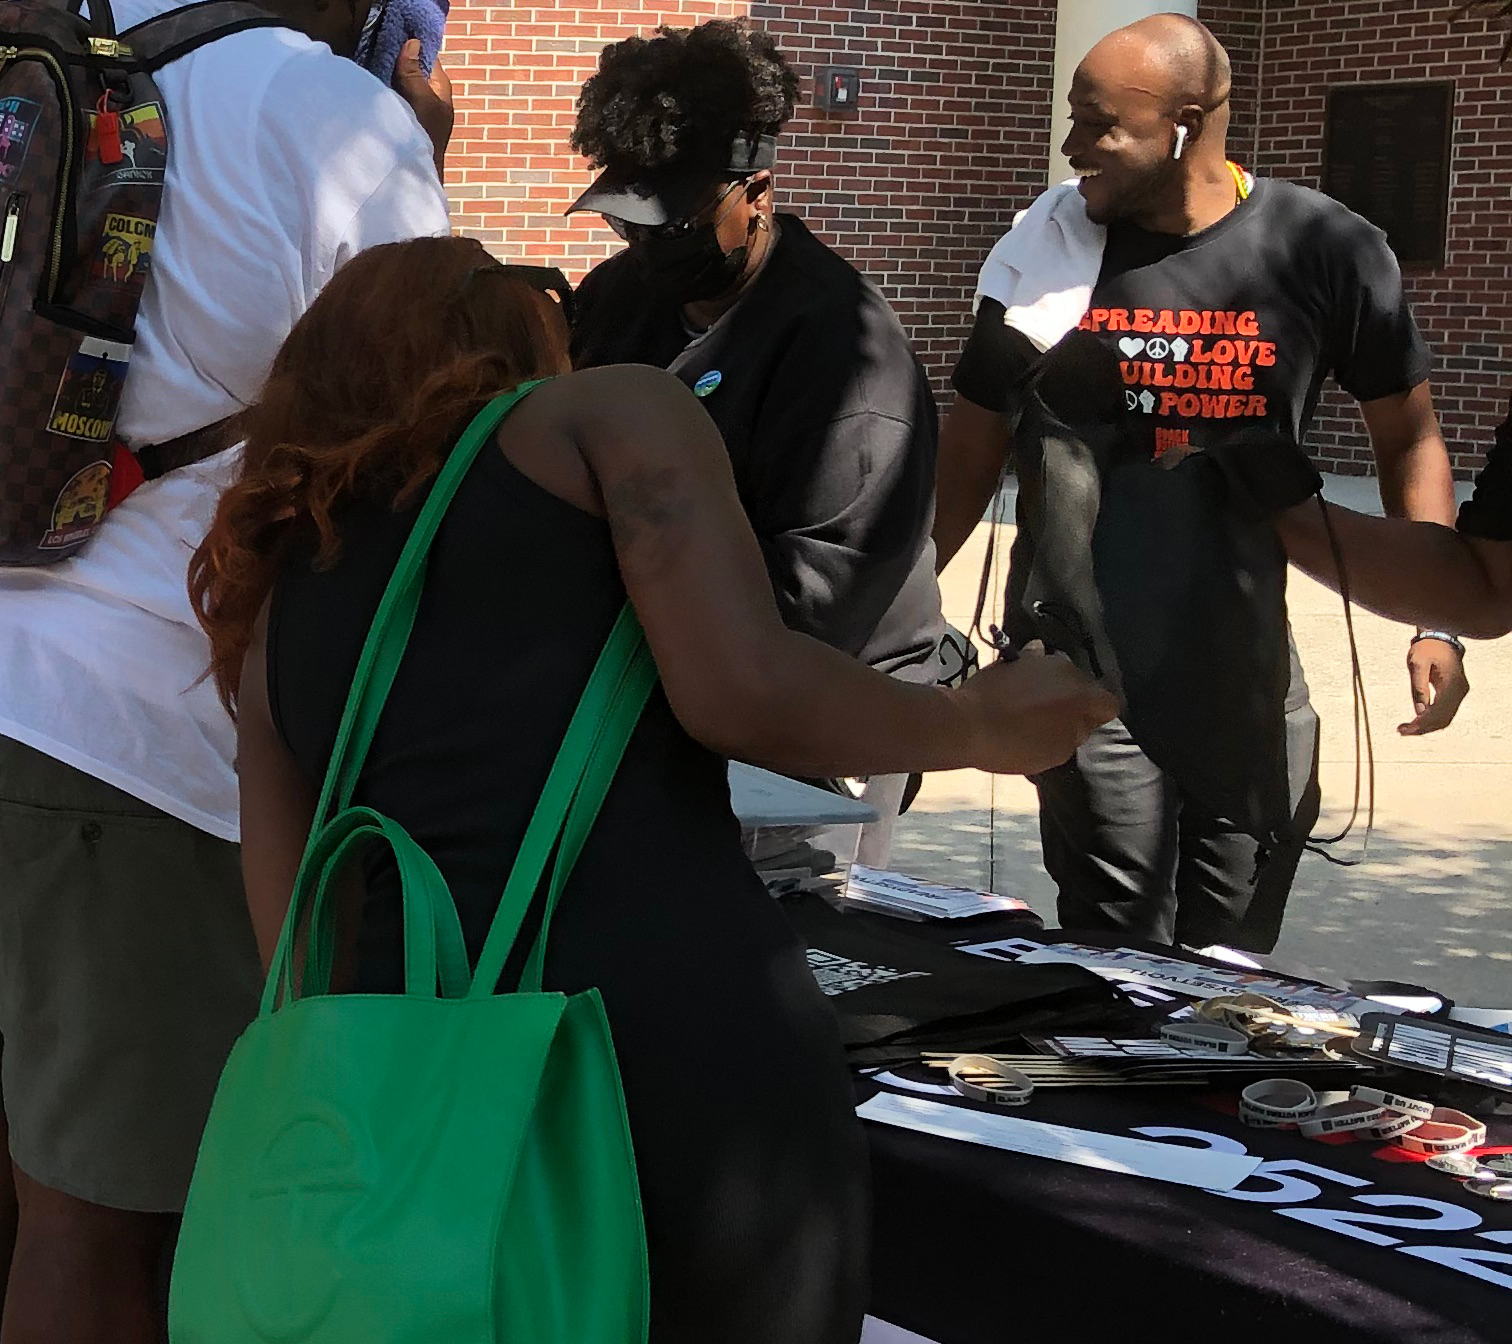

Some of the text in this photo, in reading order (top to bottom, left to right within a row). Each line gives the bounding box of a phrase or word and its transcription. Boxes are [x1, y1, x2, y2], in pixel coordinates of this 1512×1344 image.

[1189, 338, 1277, 367] LOVE
[1119, 360, 1255, 391] UILDING
[1157, 390, 1268, 419] POWER
